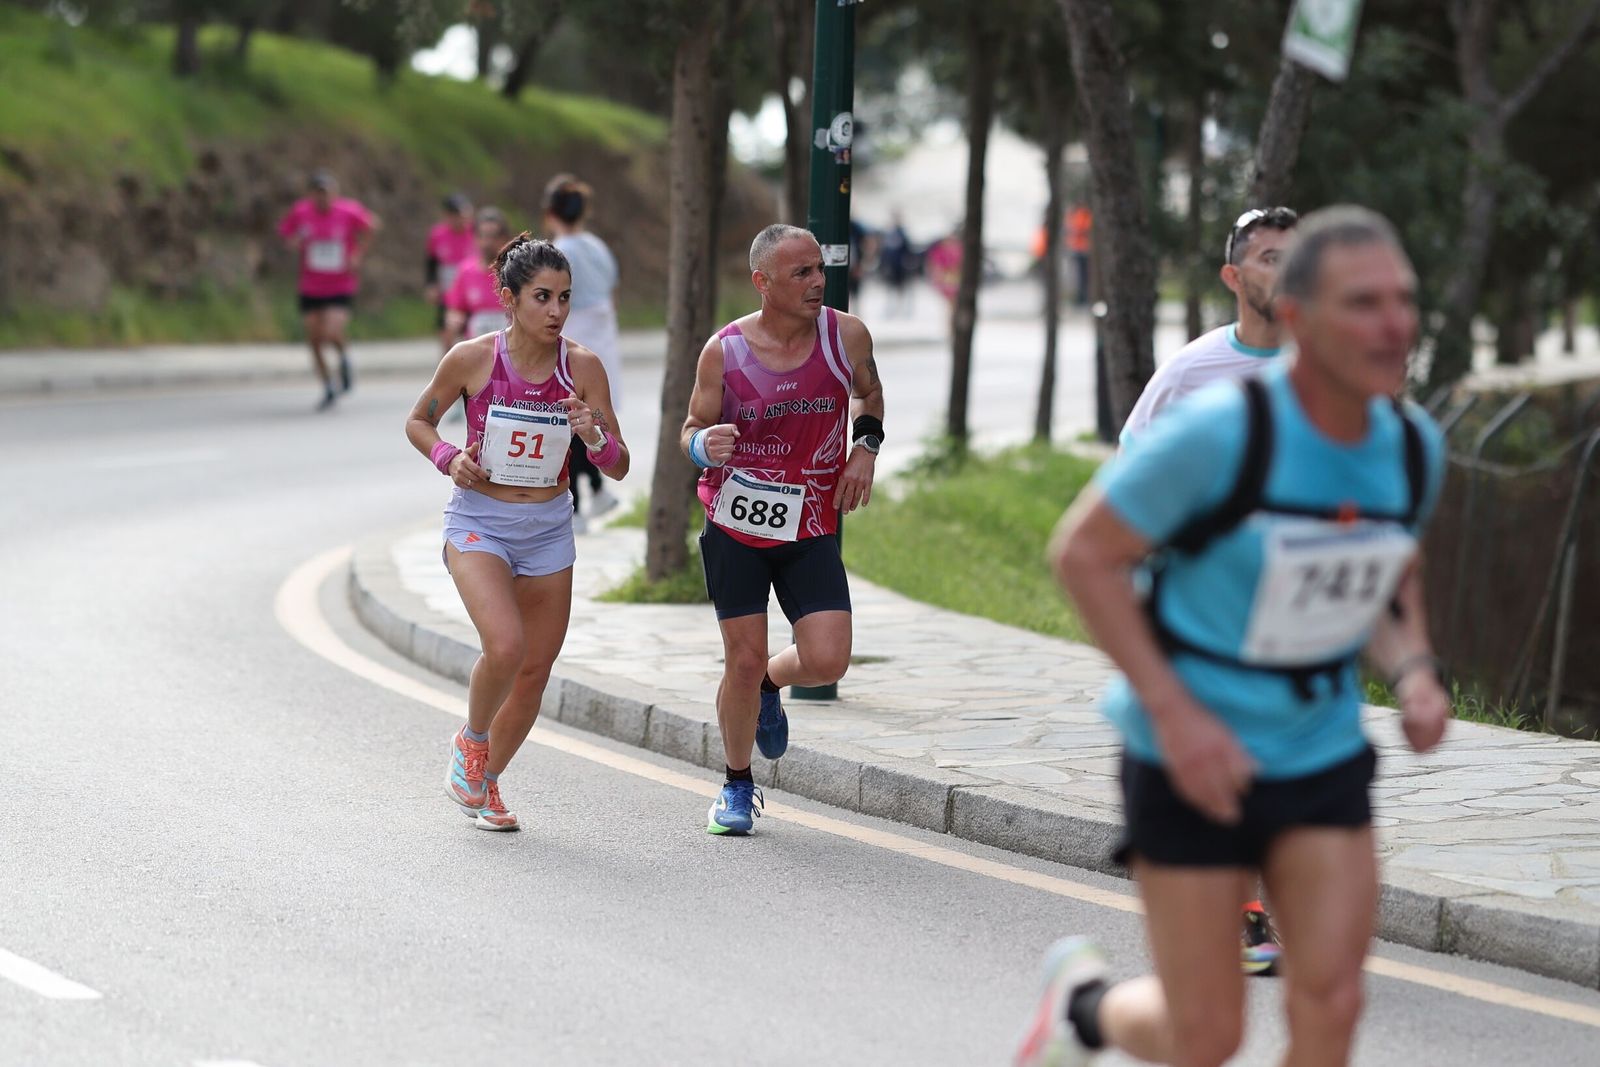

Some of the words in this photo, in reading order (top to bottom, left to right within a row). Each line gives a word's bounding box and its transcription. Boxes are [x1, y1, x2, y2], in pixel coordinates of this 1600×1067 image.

[776, 381, 798, 392] vive
[492, 395, 506, 406] LA
[510, 399, 569, 414] ANTORCHA
[740, 404, 757, 420] LA
[764, 397, 836, 419] ANTORCHA
[507, 430, 545, 459] 51
[733, 441, 792, 456] OBERBIO
[730, 495, 789, 529] 688
